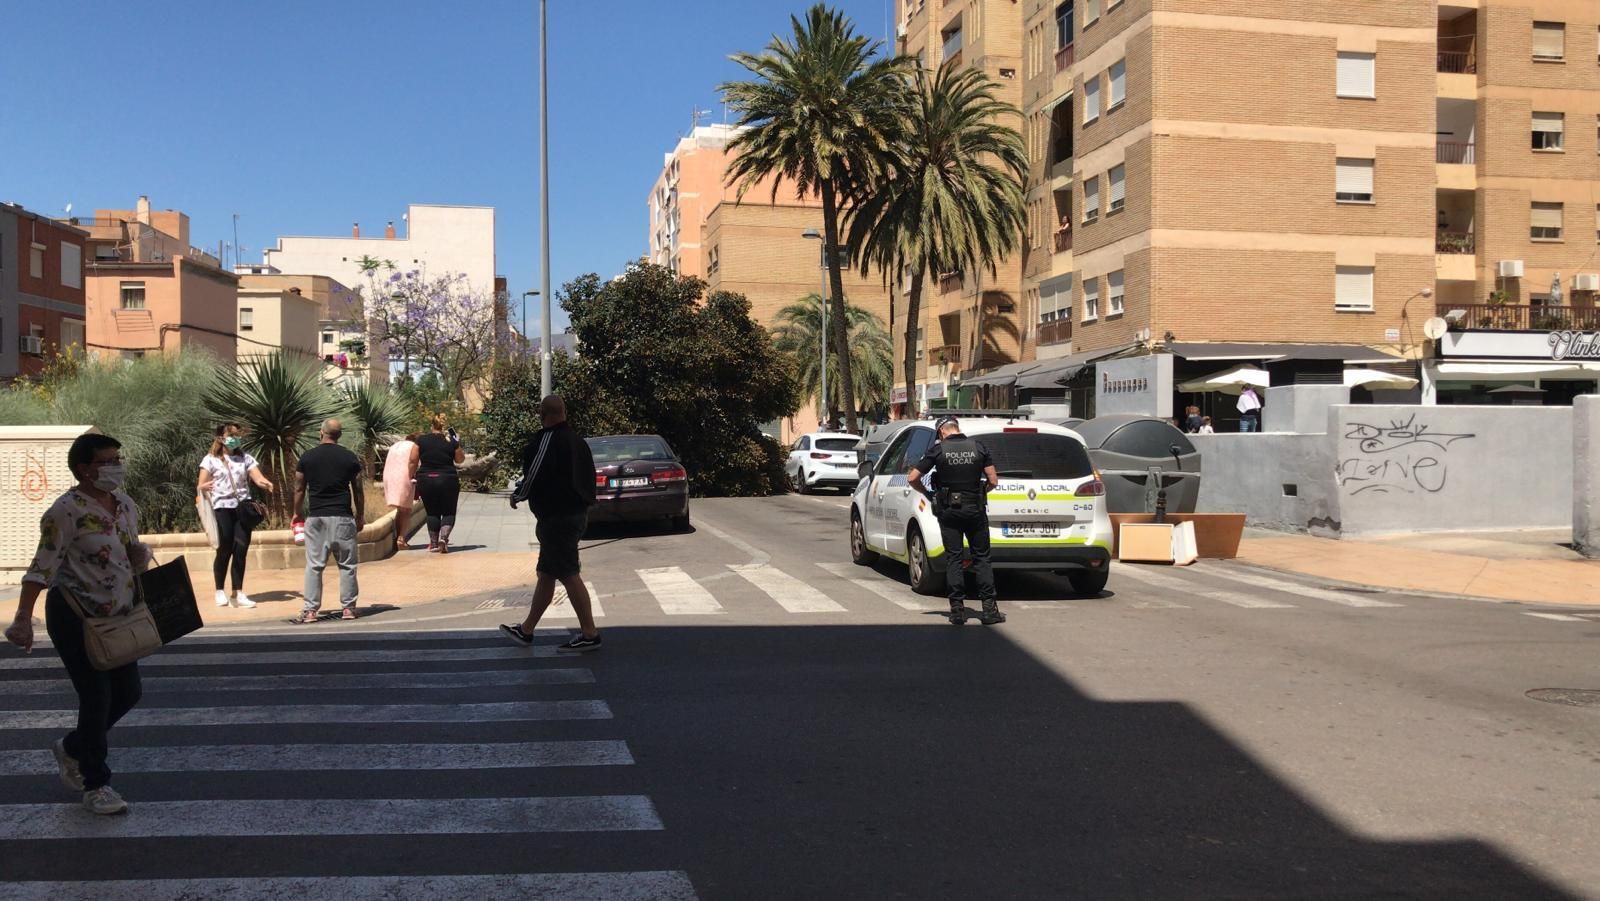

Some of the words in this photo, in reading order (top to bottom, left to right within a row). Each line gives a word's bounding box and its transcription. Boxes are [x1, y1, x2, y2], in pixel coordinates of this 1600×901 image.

[945, 451, 976, 459] POLICIA
[995, 483, 1025, 491] OLICÍA
[1010, 523, 1035, 533] 9244
